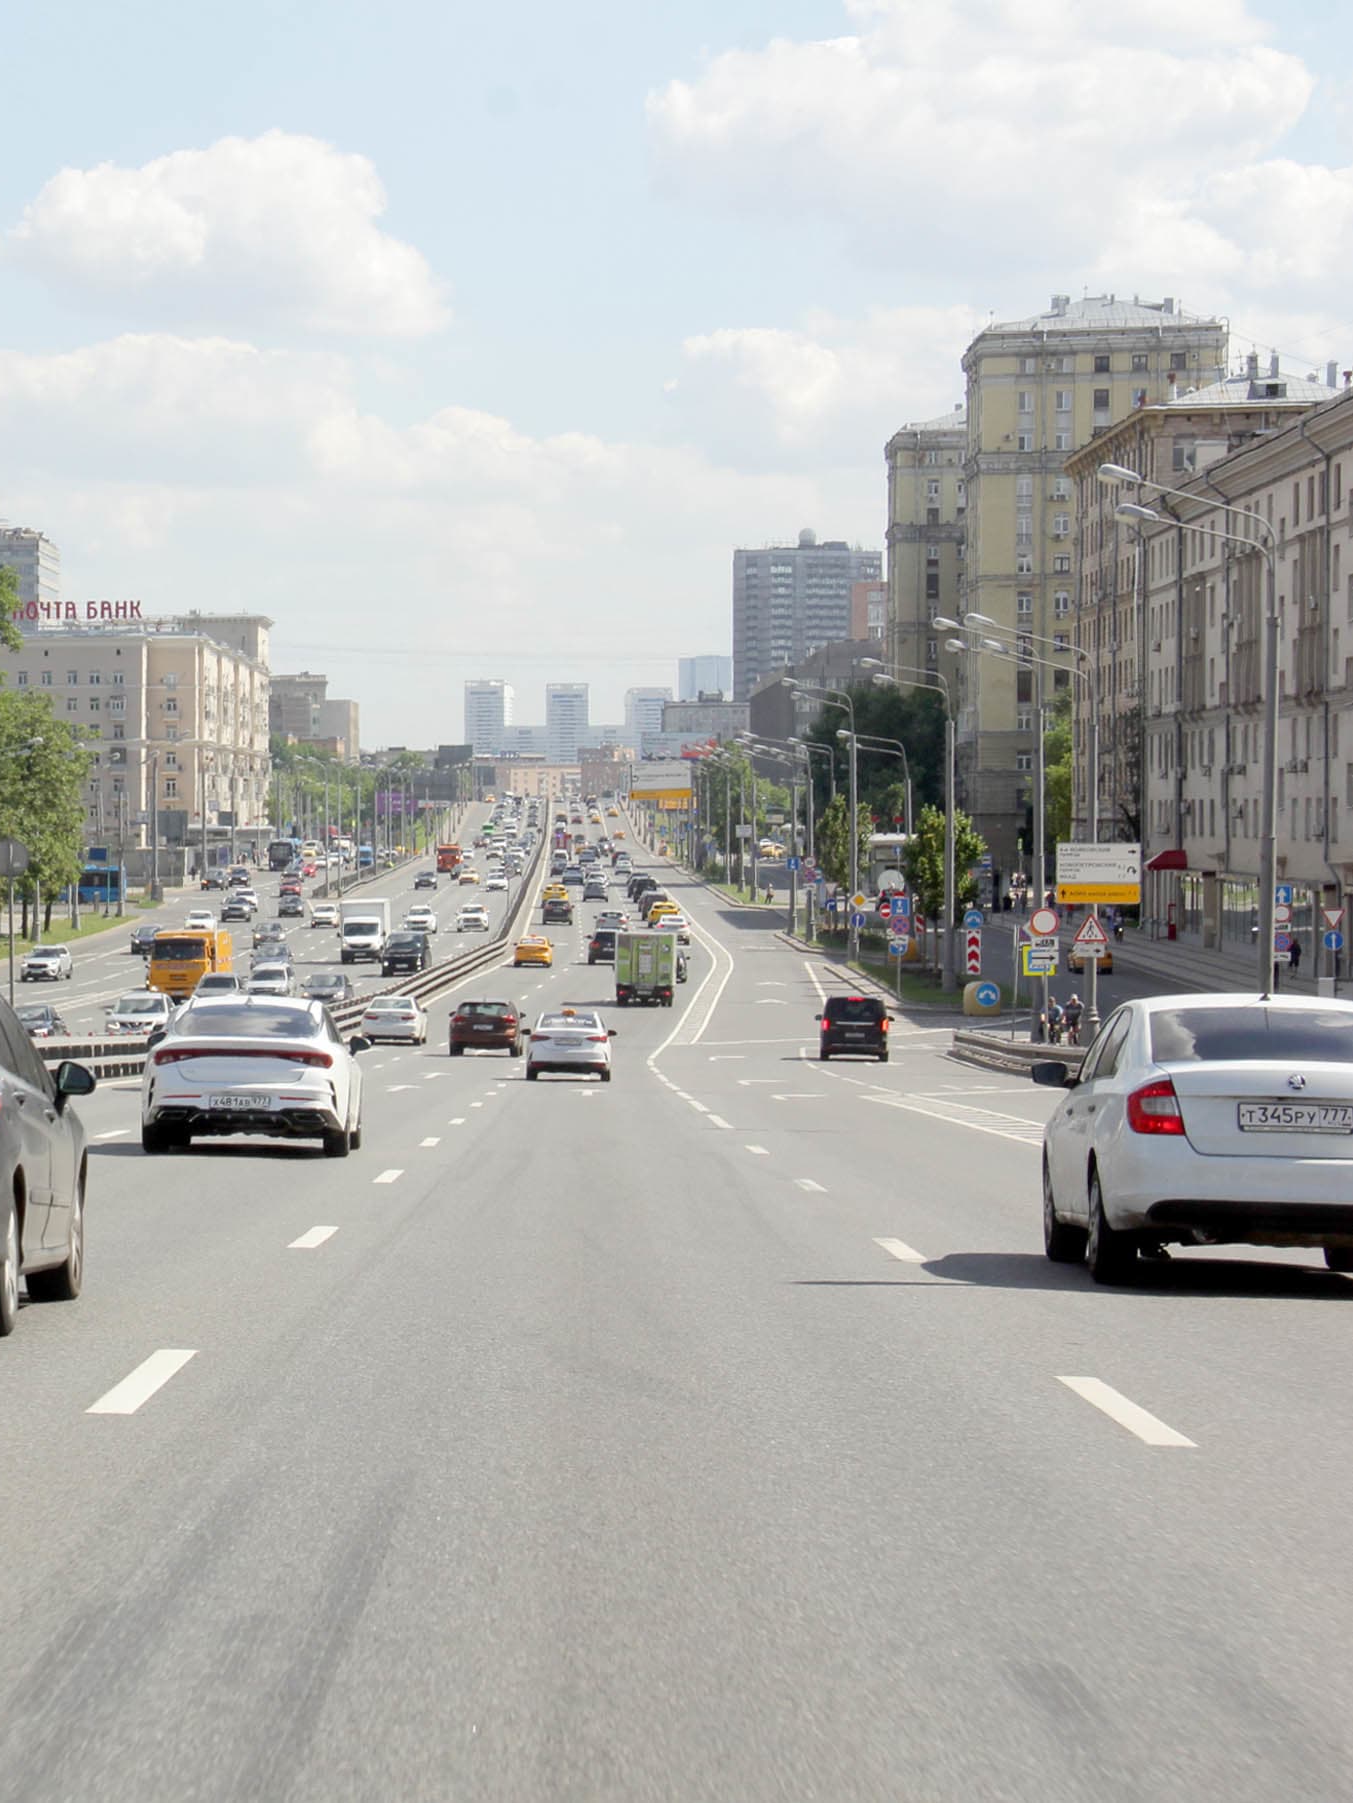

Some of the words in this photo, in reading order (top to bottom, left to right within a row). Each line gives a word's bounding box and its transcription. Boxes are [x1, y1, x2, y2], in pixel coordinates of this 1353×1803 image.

[87, 600, 142, 619] БАНК
[1246, 1106, 1316, 1124] Т345РУ
[1320, 1107, 1348, 1121] 777
